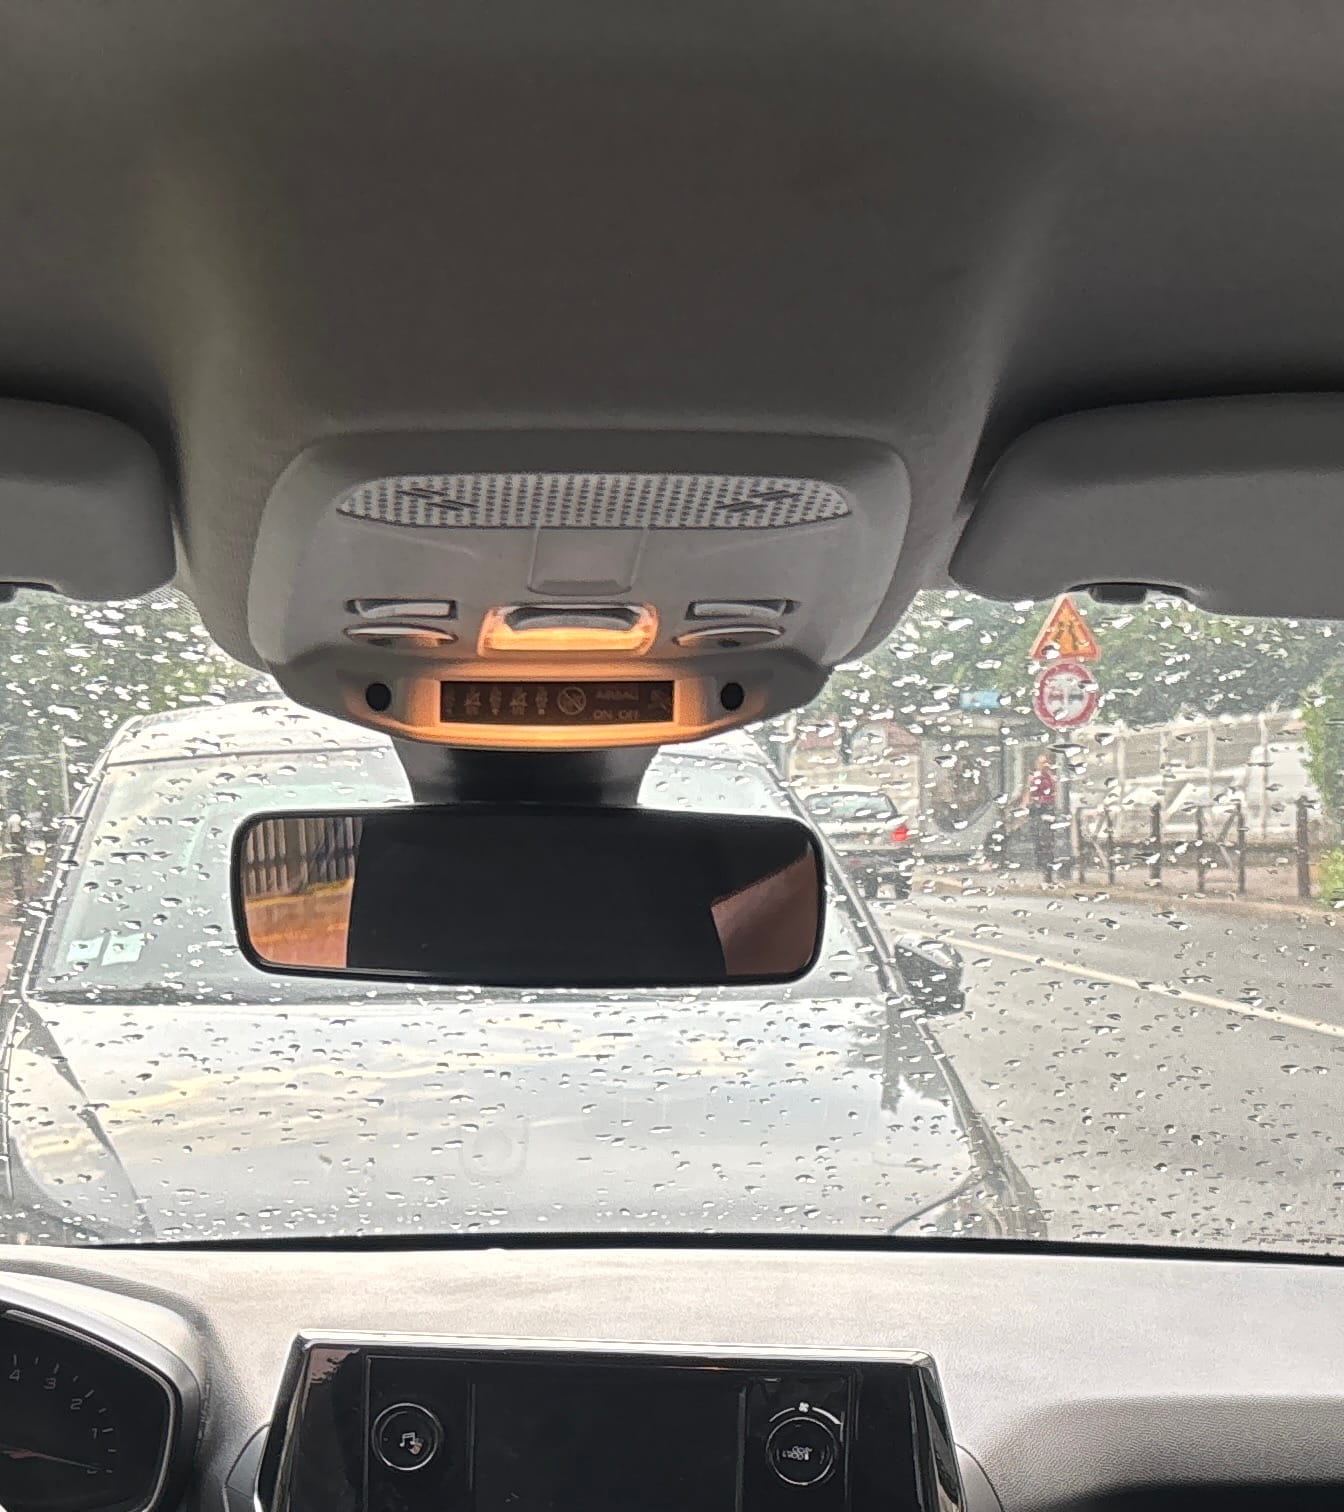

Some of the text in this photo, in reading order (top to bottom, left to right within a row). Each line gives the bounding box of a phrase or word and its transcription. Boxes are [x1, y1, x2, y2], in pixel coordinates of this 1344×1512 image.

[9, 1369, 21, 1381] 4
[43, 1377, 57, 1390] 3
[70, 1398, 83, 1410] 2
[91, 1428, 98, 1439] 1
